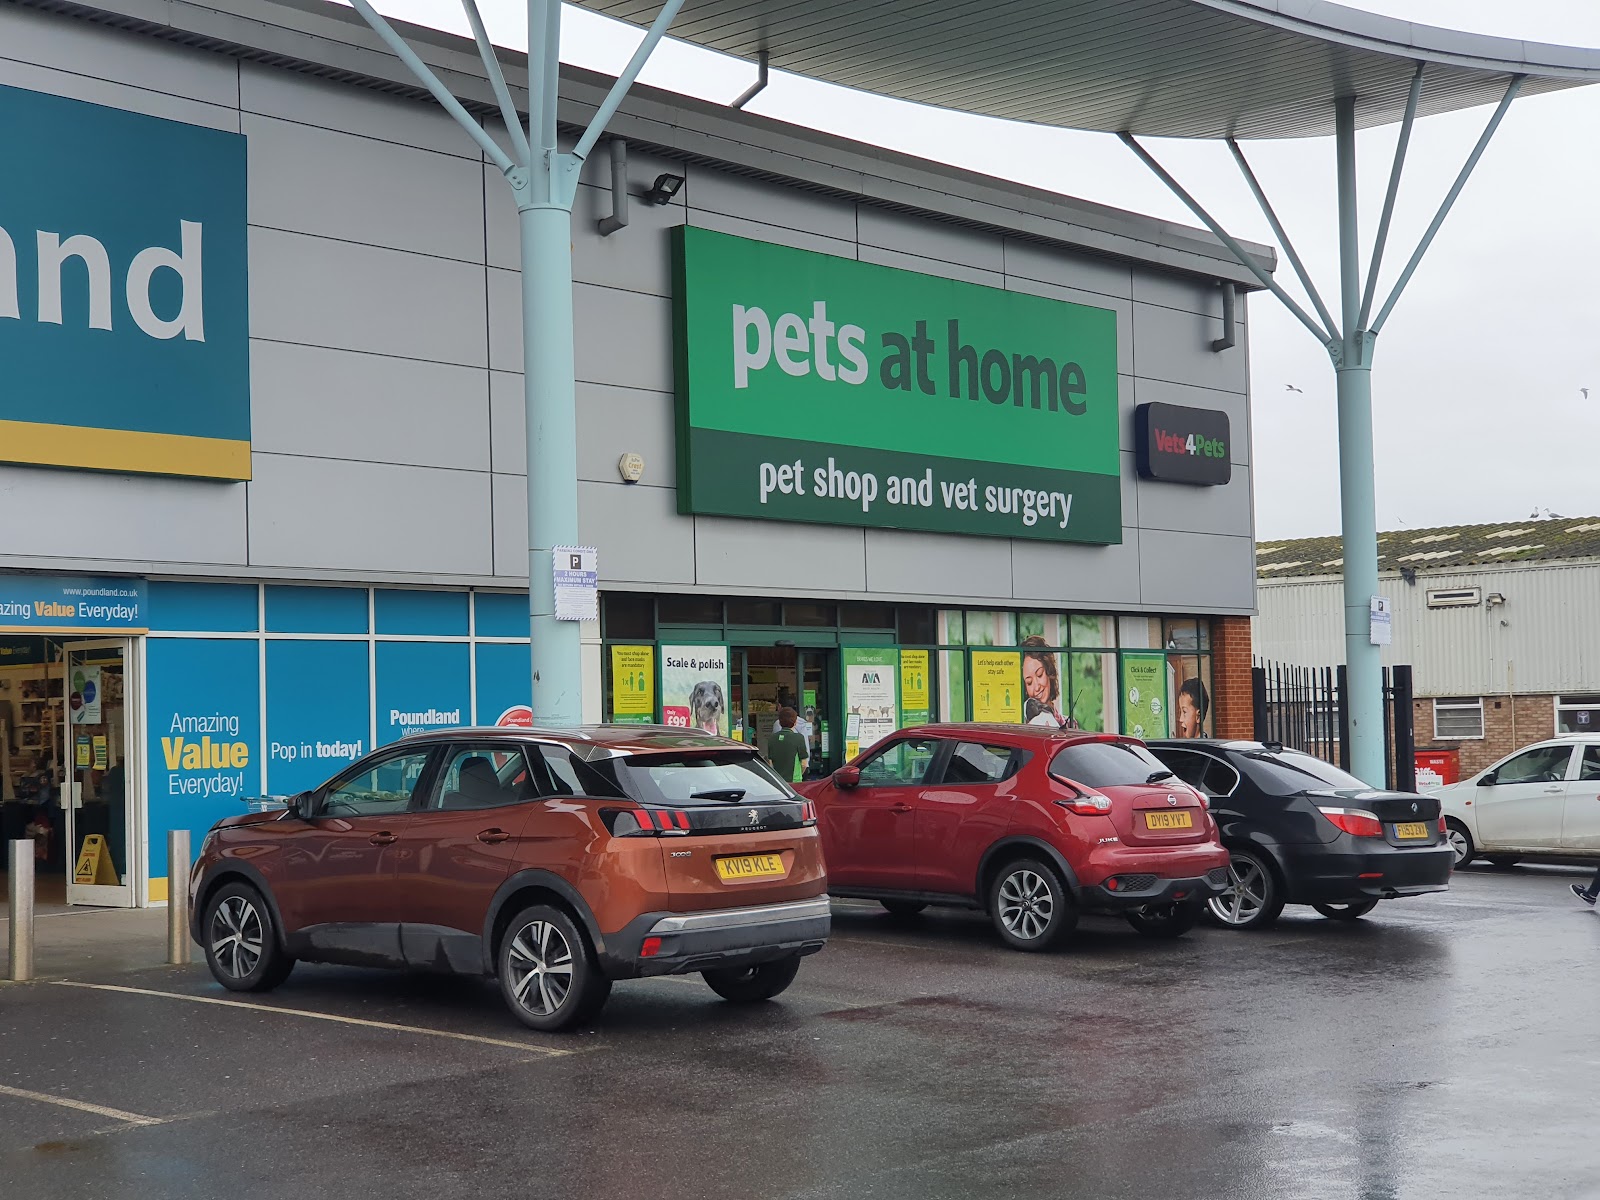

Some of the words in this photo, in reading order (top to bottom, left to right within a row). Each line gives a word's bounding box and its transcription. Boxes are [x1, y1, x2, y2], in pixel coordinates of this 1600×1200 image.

[733, 300, 869, 389] pets
[880, 320, 937, 396] at
[947, 318, 1088, 416] home
[1154, 428, 1225, 458] Vets4Pets
[759, 459, 806, 504] pet
[813, 457, 878, 512] shop
[886, 468, 933, 507] and
[940, 477, 978, 511] vet
[985, 484, 1073, 529] surgery
[572, 556, 579, 567] P
[63, 587, 138, 597] www.poundland.co.uk
[34, 601, 75, 617] Value
[79, 602, 138, 621] Everyday!
[666, 657, 689, 669] Scale
[690, 658, 697, 669] &
[698, 658, 724, 671] polish
[170, 712, 239, 736] Amazing
[390, 709, 460, 726] Poundland
[161, 736, 249, 770] Value
[271, 743, 297, 762] Pop
[301, 741, 313, 758] in
[316, 739, 362, 760] today!
[168, 772, 243, 798] Everyday!
[1151, 814, 1170, 827] DY19
[1171, 813, 1186, 826] YVT
[1097, 836, 1119, 844] JUKE
[724, 858, 753, 875] KV19
[754, 856, 777, 873] KLE
